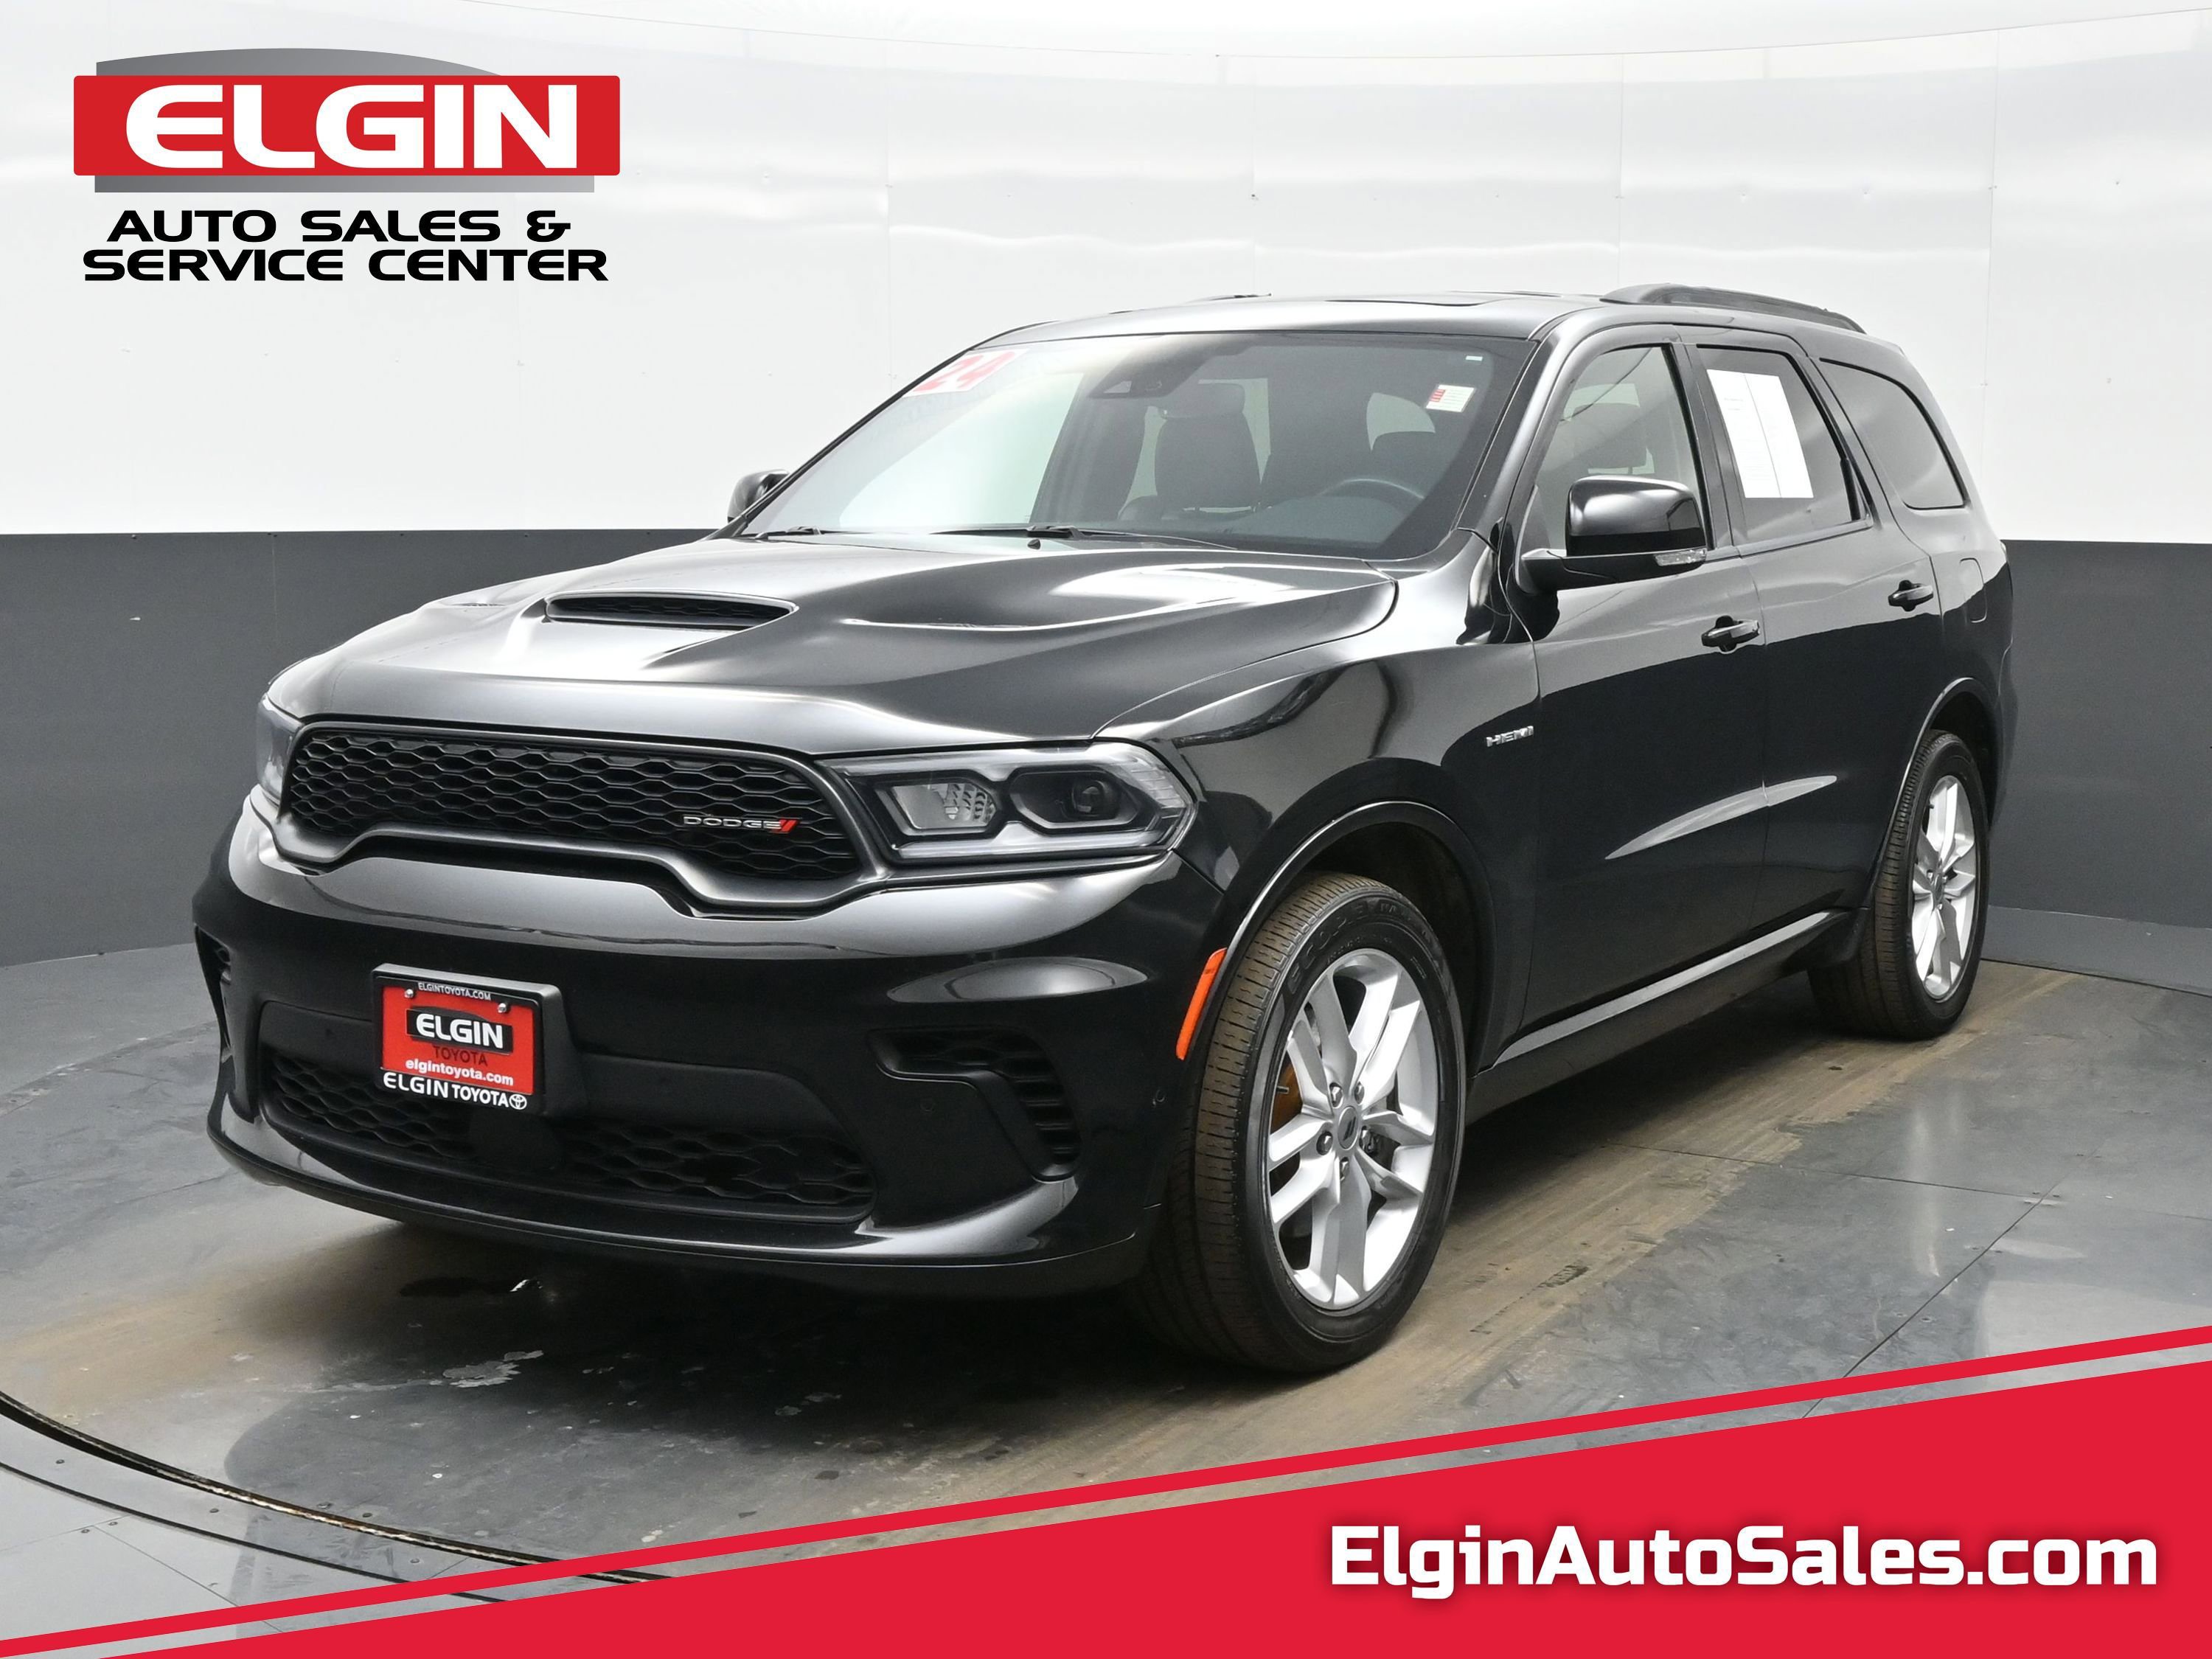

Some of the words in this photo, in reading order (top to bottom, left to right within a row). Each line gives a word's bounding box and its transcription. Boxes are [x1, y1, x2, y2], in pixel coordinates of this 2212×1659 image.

[1486, 726, 1534, 747] HEMI
[683, 815, 782, 830] DODGE
[418, 982, 492, 1001] ELGINTOYOTA.COM
[416, 1013, 504, 1049] ELGIN
[432, 1046, 487, 1067] TOYOTA
[406, 1058, 514, 1086] elgintoyota.com
[383, 1072, 448, 1099] ELGIN
[451, 1084, 509, 1108] TOYOTA
